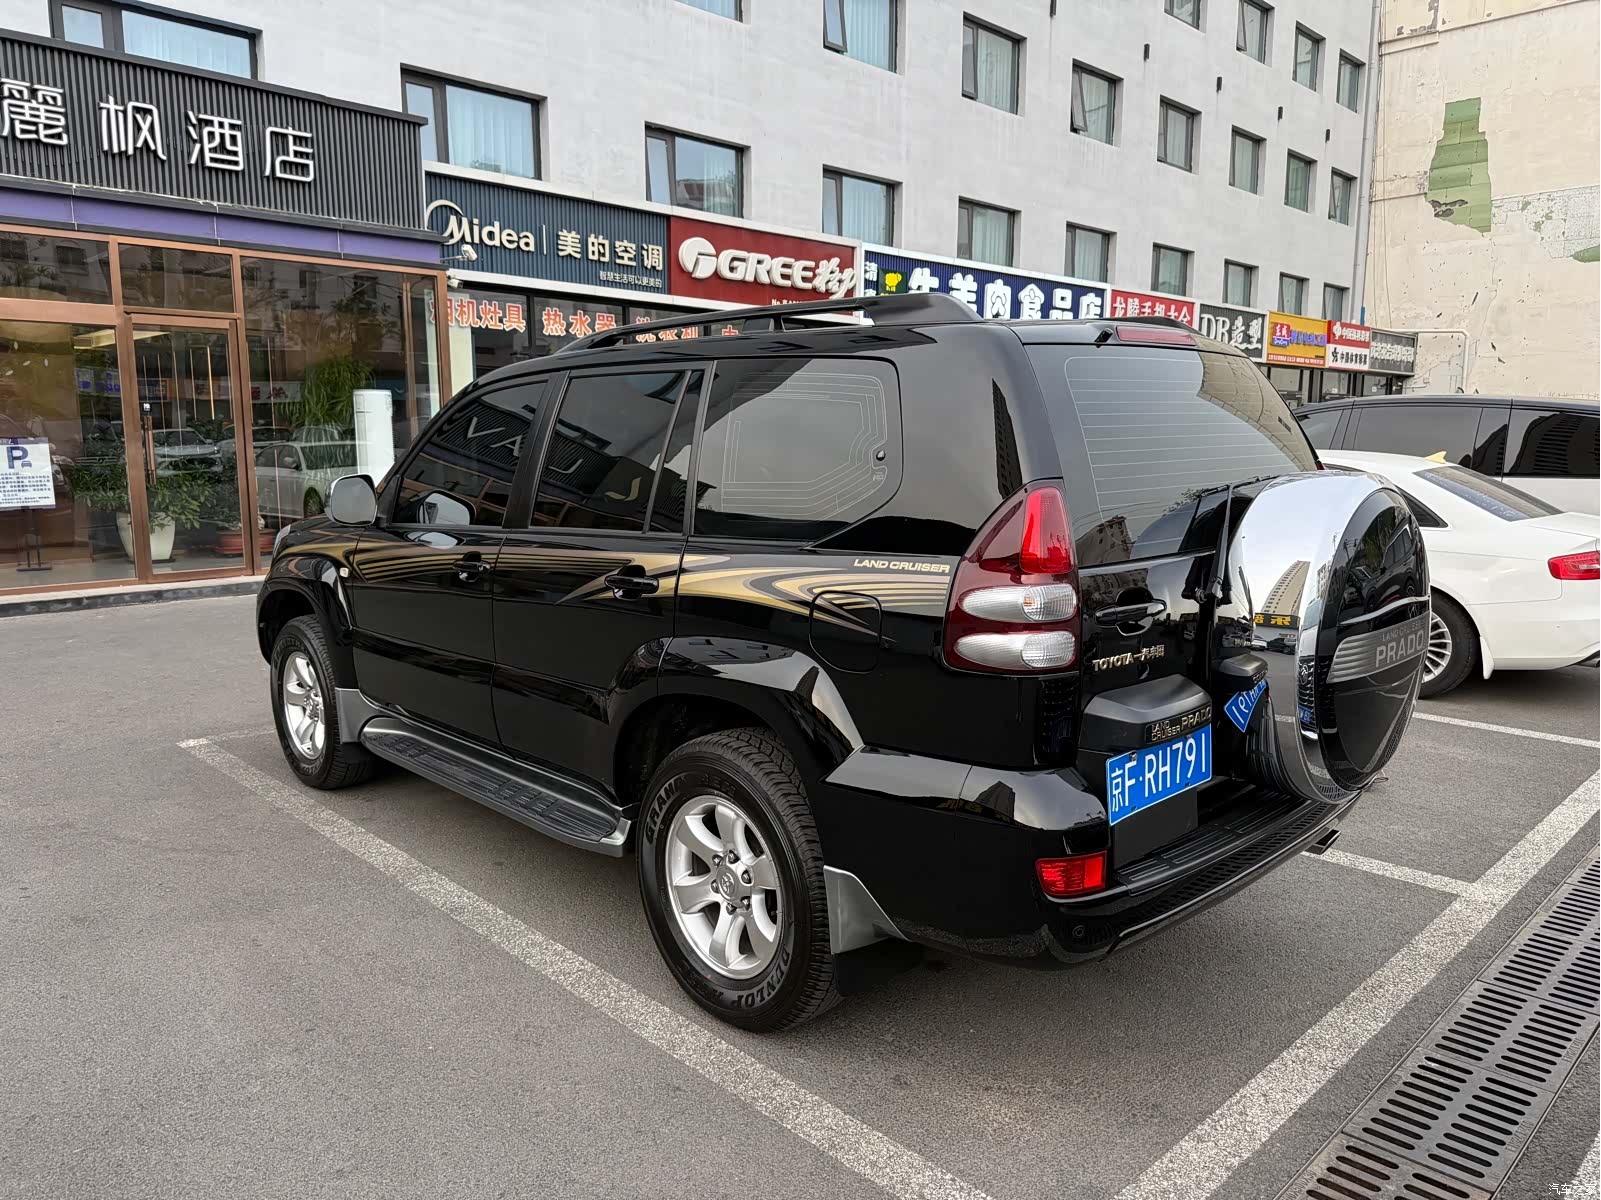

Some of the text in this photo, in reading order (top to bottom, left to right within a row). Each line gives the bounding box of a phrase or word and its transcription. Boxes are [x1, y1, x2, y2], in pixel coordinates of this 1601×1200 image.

[0, 77, 315, 182] 麗枫酒店
[440, 211, 535, 252] Midea
[557, 228, 664, 271] 美的空调
[599, 270, 663, 288] 智慧生活可以更美的
[717, 249, 815, 290] GREE
[908, 267, 1102, 320] 牛羊肉食品店
[542, 305, 618, 338] 热水器
[6, 446, 29, 469] P
[853, 558, 951, 573] LAND CRUISER
[1092, 652, 1135, 672] TOYOTA
[1375, 630, 1425, 667] PRADO
[1151, 706, 1212, 741] CRUISER PRADO
[1151, 720, 1170, 733] LAND
[1111, 732, 1206, 812] 京F·RH791
[729, 945, 793, 1009] DUNLOP
